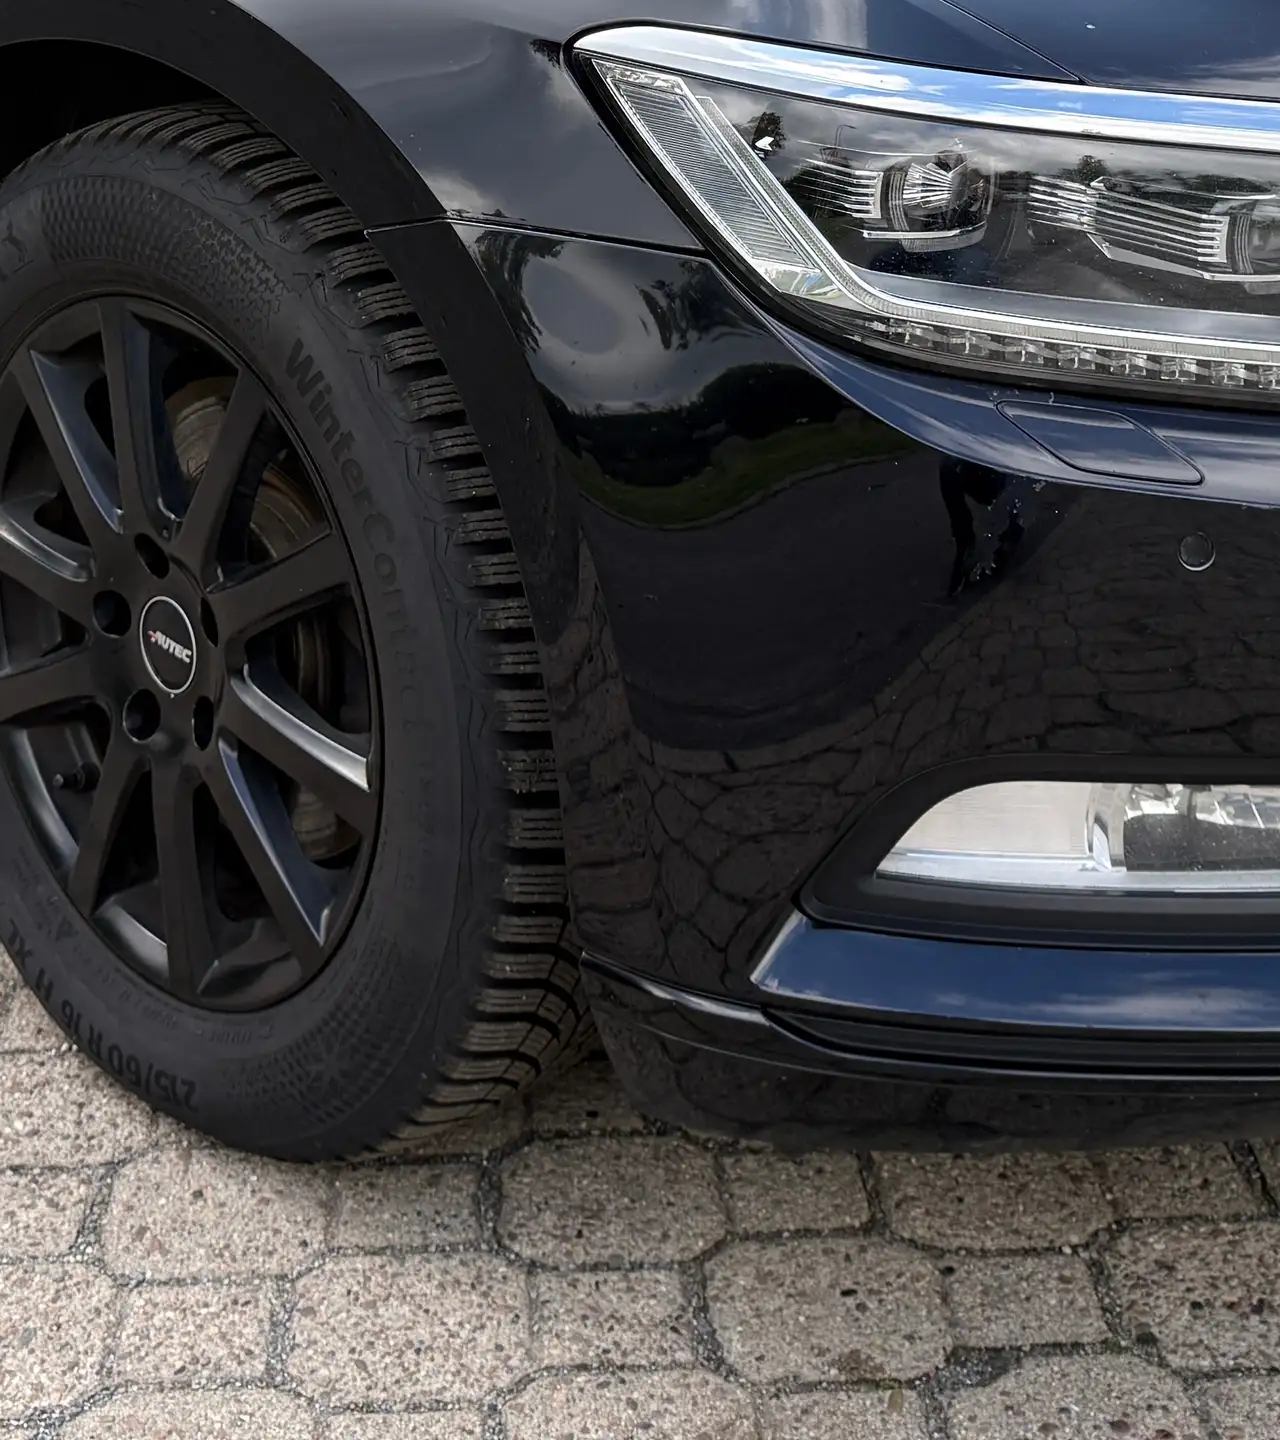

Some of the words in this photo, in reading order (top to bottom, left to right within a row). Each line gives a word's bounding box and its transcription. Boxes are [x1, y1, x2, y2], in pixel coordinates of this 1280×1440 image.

[148, 630, 193, 664] AUTEC
[8, 918, 33, 966] XL
[35, 967, 54, 1002] H
[61, 998, 83, 1034] 16
[86, 1023, 104, 1061] R
[107, 1043, 200, 1112] 215/60
